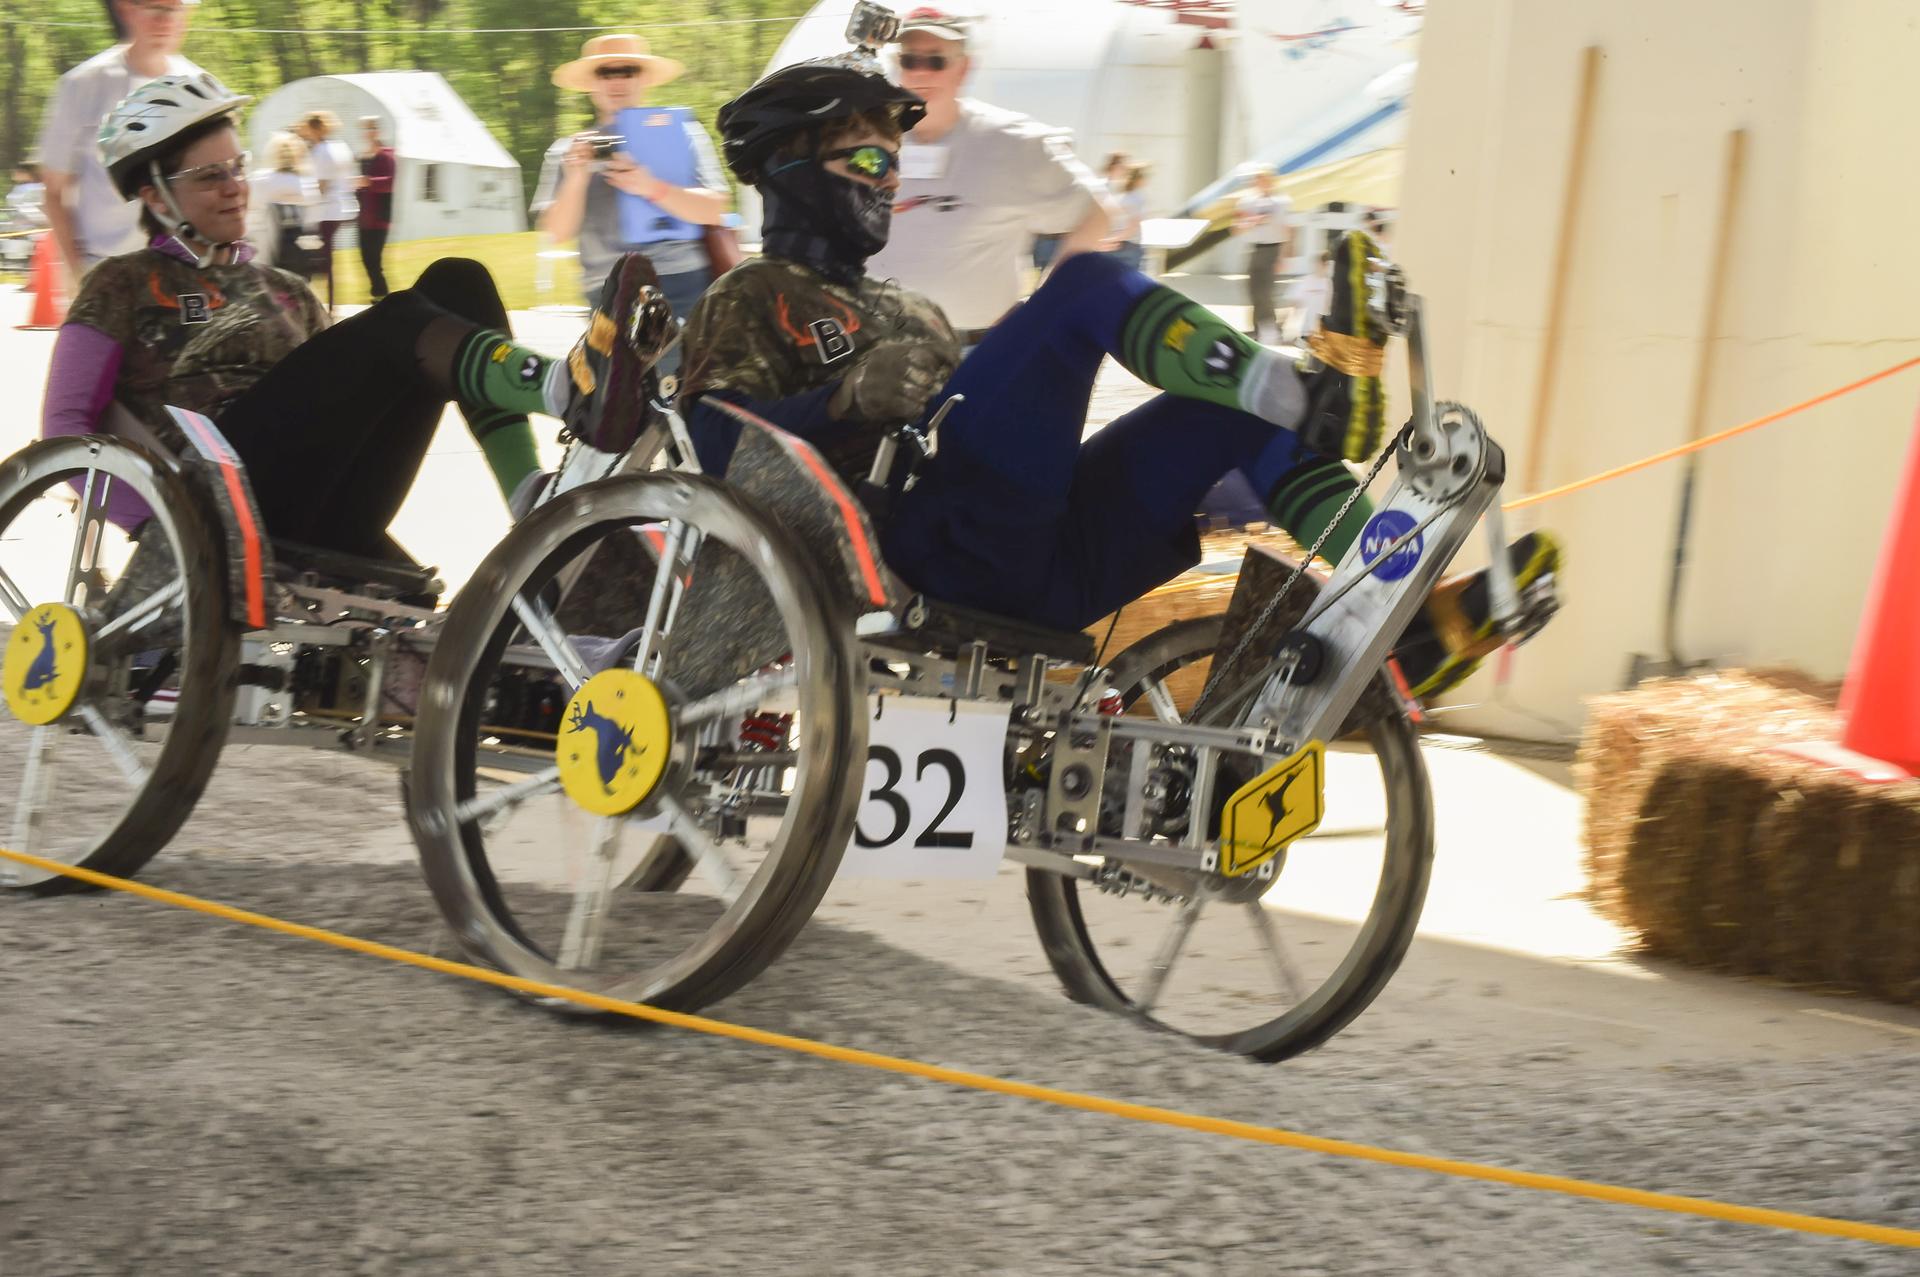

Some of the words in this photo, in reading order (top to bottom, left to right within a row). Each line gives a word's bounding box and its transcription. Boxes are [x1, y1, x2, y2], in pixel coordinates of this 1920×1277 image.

[178, 293, 213, 325] B
[808, 317, 855, 365] B
[855, 745, 974, 849] 32
